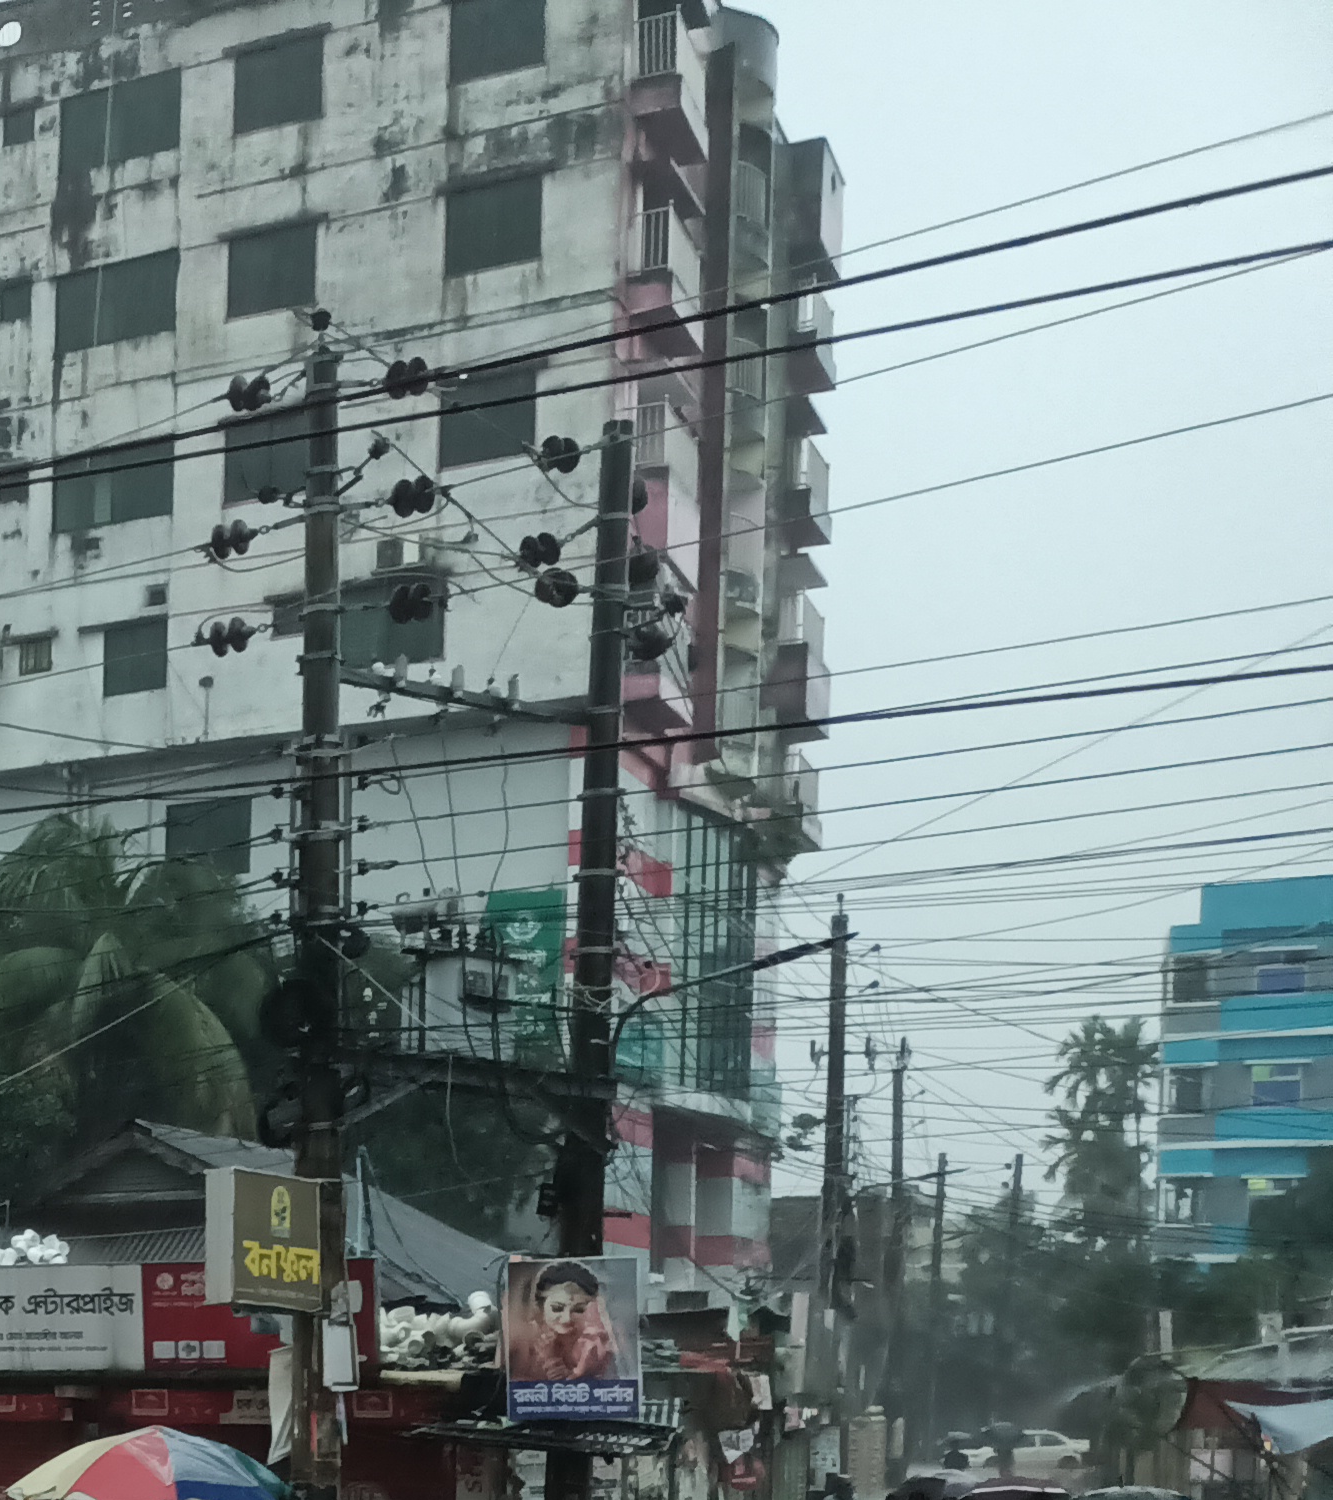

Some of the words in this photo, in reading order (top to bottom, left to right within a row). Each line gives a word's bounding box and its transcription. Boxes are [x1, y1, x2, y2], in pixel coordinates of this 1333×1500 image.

[242, 1240, 319, 1285] বনফুল
[21, 1287, 136, 1316] এন্টারপ্রাইজ
[551, 1383, 590, 1402] বিউটি
[593, 1384, 634, 1402] পার্লার
